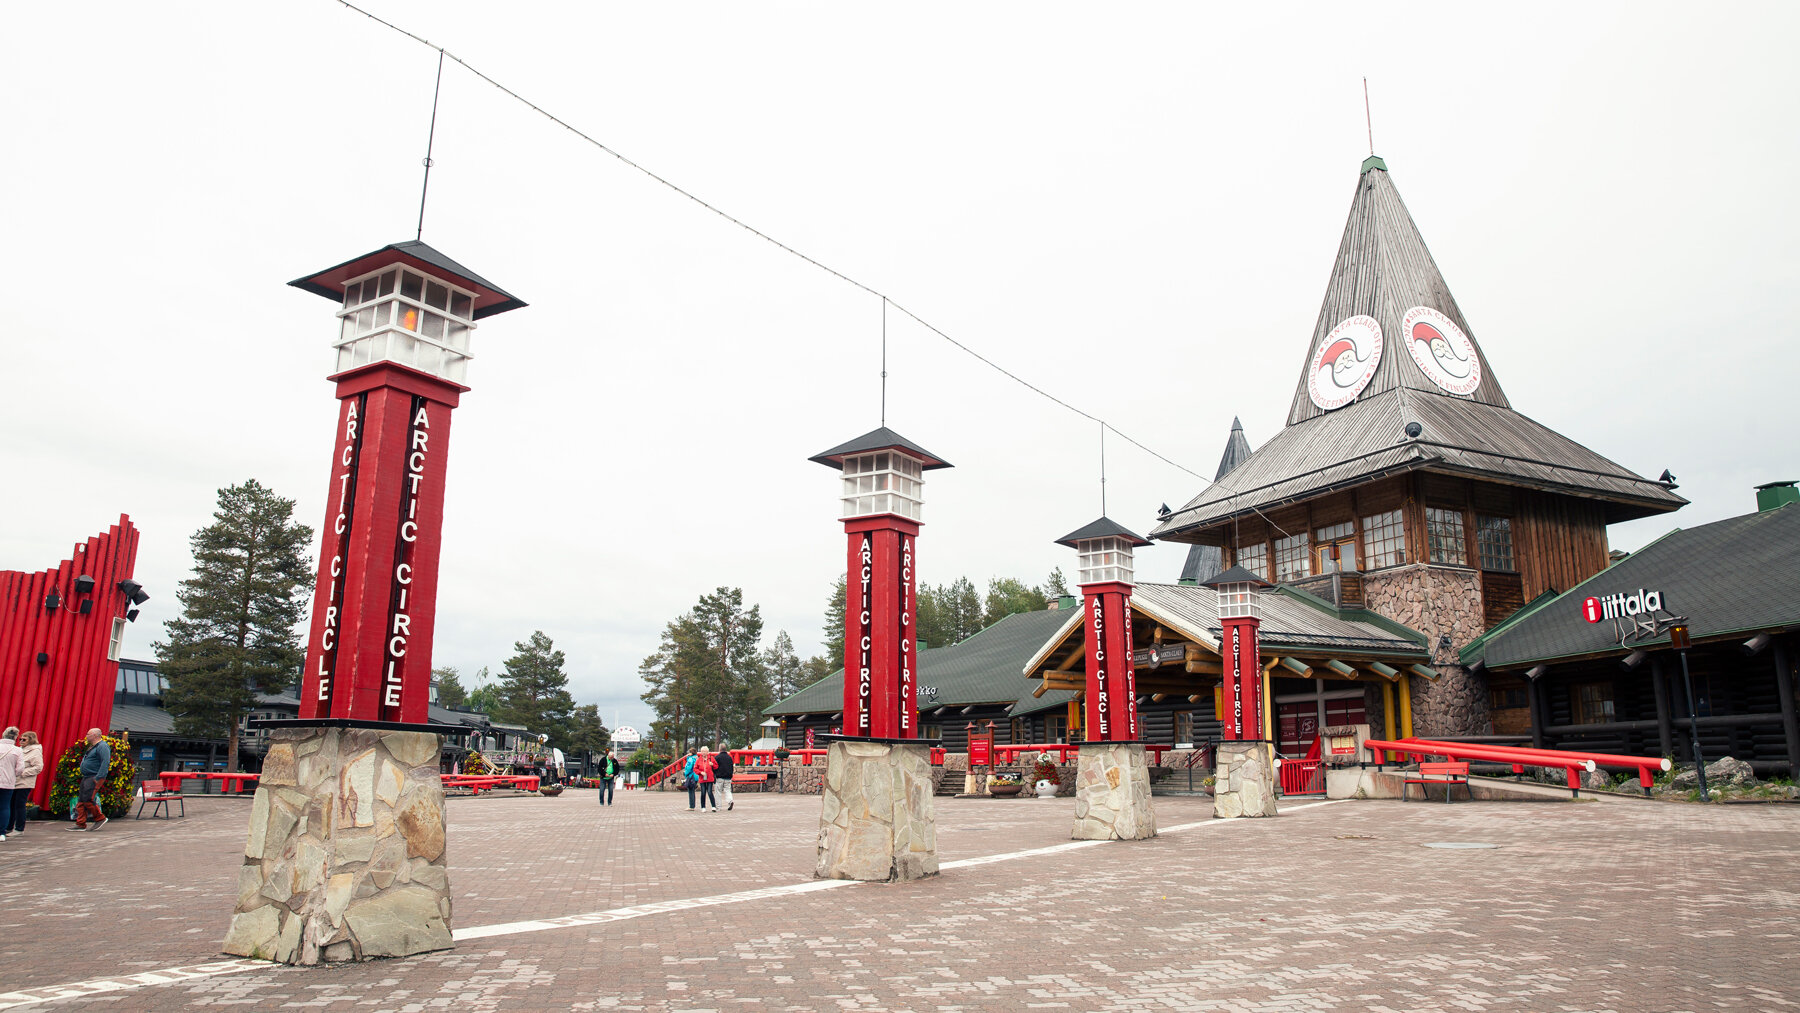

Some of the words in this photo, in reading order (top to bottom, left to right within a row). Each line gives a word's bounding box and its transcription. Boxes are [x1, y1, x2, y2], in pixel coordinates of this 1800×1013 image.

[1309, 353, 1321, 388] ARCTIC
[1324, 320, 1351, 346] SANTA
[1353, 317, 1377, 332] CLAUS
[1369, 332, 1381, 371] OFFICE
[1408, 308, 1432, 320] SANTA
[1434, 312, 1462, 337] CLAUS
[1463, 340, 1479, 376] OFFICE
[1311, 388, 1331, 407] CIRCLE
[1331, 379, 1366, 407] FINLAND
[1415, 356, 1444, 386] CIRCLE
[1445, 379, 1475, 393] FINLAND
[334, 401, 358, 535] ARCTIC
[401, 407, 429, 542] ARCTIC
[860, 538, 872, 624] ARCTIC
[902, 539, 911, 626] ARCTIC
[1601, 588, 1663, 620] iittala
[318, 555, 341, 700] CIRCLE
[385, 563, 412, 706] CIRCLE
[1092, 598, 1104, 660] ARCTIC
[1232, 627, 1240, 677] ARCTIC
[859, 636, 871, 727] CIRCLE
[902, 639, 910, 728] CIRCLE
[916, 686, 936, 696] ekko
[1097, 670, 1108, 733] CIRCLE
[1127, 670, 1135, 733] CIRCLE
[1233, 684, 1241, 734] CIRCLE
